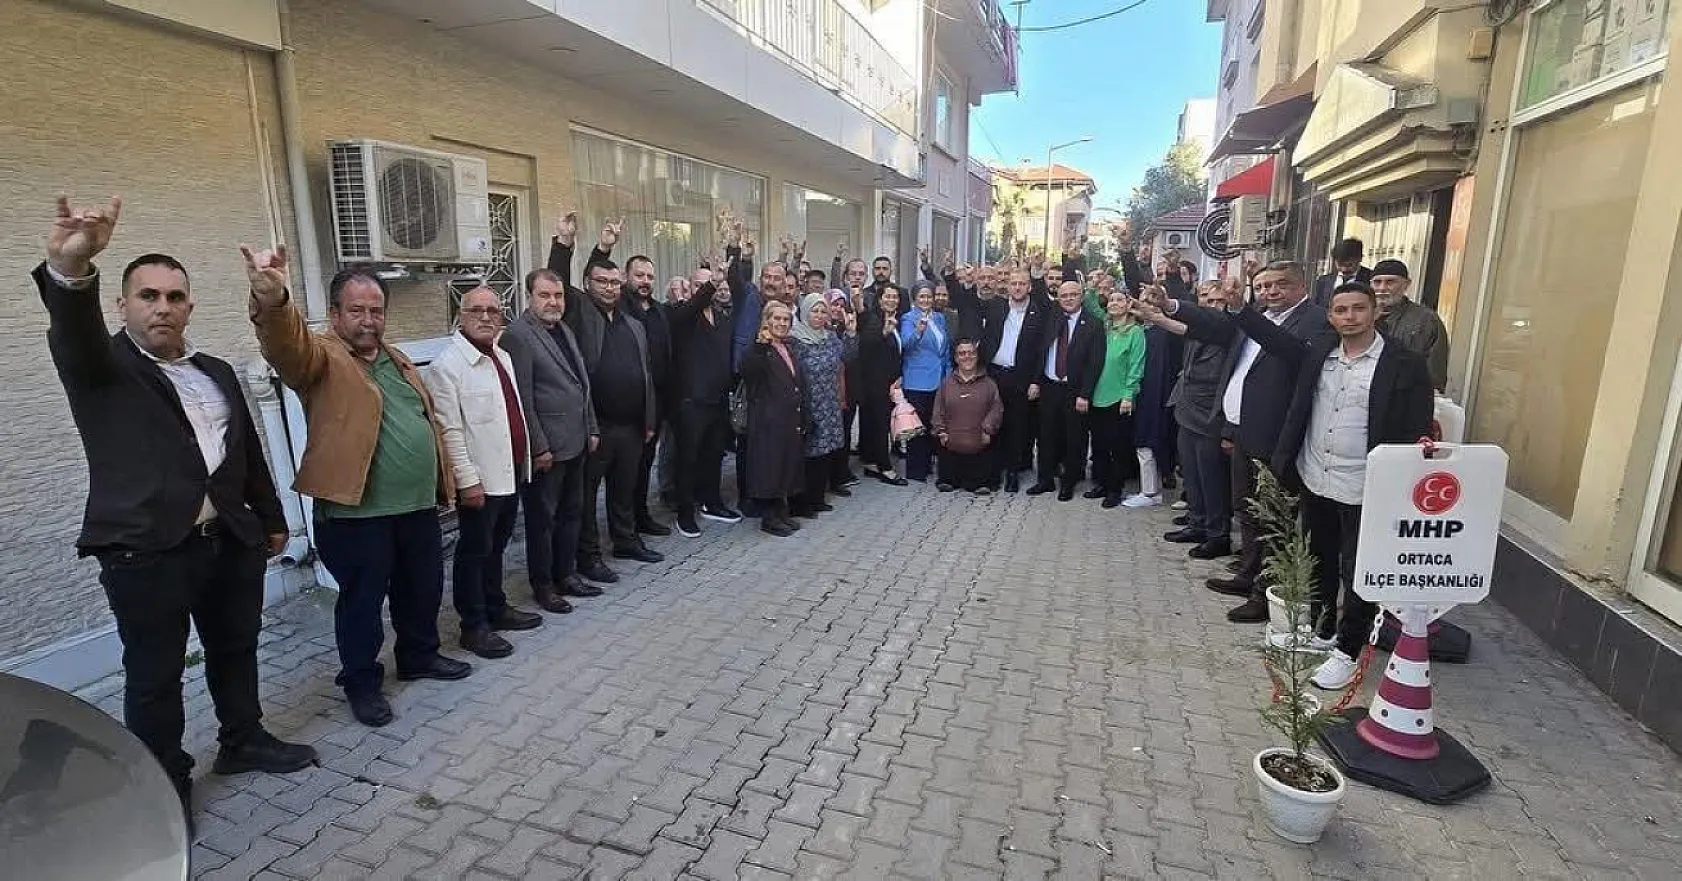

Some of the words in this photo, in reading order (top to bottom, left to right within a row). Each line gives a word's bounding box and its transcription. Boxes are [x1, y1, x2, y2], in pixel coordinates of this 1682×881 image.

[1398, 520, 1464, 538] MHP
[1397, 553, 1453, 566] ORTACA
[1365, 571, 1395, 588] İLÇE
[1399, 573, 1484, 590] BAŞKANLIĞI
